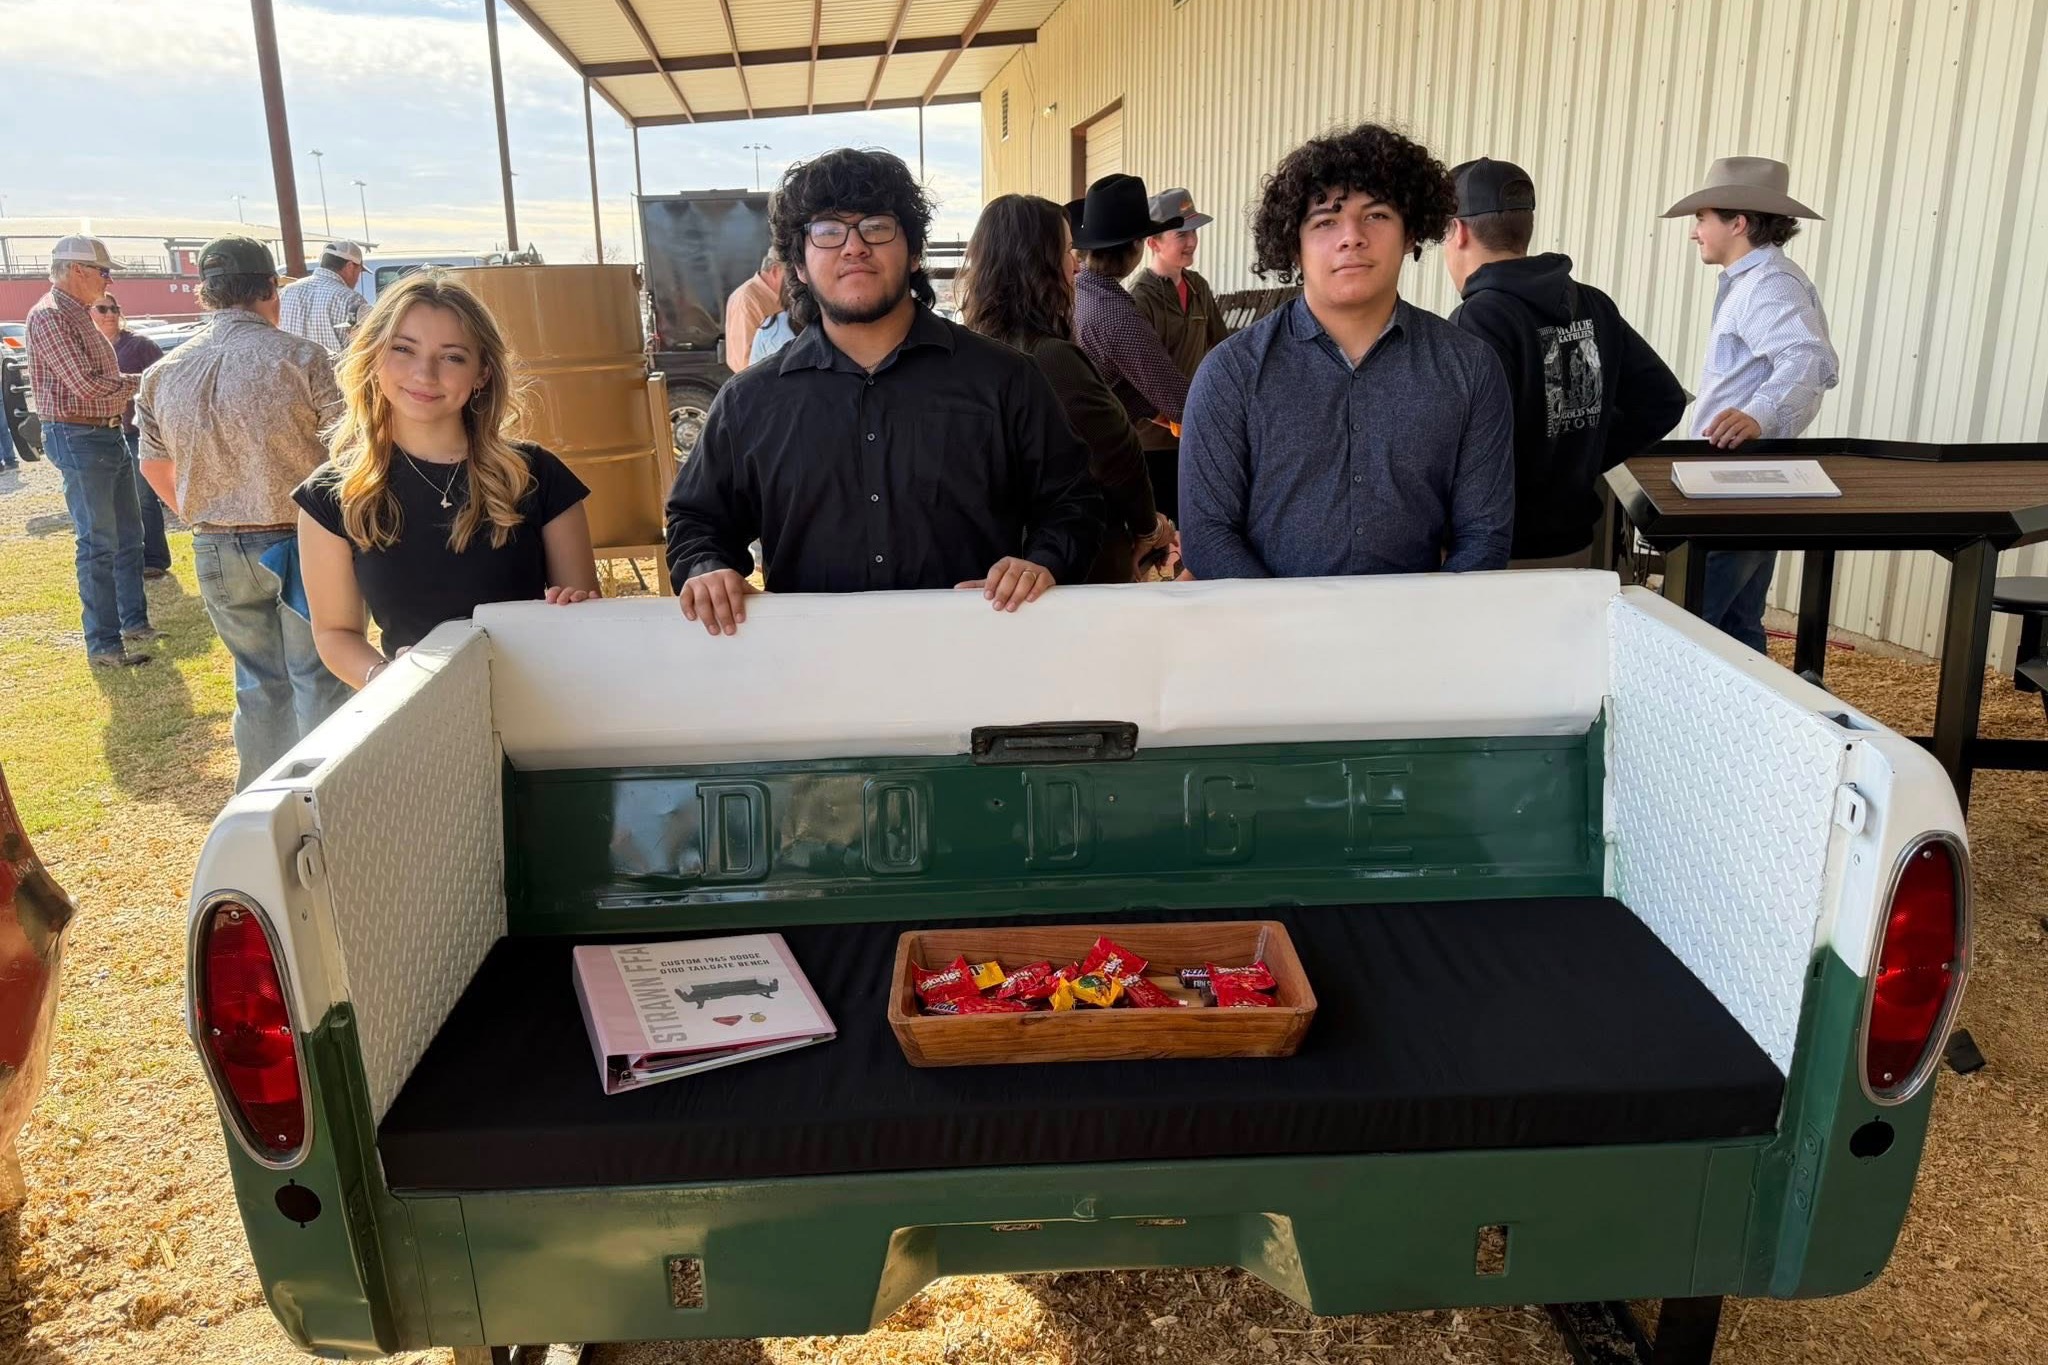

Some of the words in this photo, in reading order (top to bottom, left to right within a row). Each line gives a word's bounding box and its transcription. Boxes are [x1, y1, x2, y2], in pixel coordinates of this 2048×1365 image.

[697, 759, 1412, 883] DODGE
[618, 946, 657, 973] FFA
[661, 958, 701, 968] CUSTOM
[704, 955, 727, 964] 1965
[730, 952, 761, 961] DODGE
[688, 962, 734, 972] TAILGATE
[738, 959, 770, 967] BENCH
[921, 969, 961, 991] Skittles
[630, 976, 688, 1044] STRAWN
